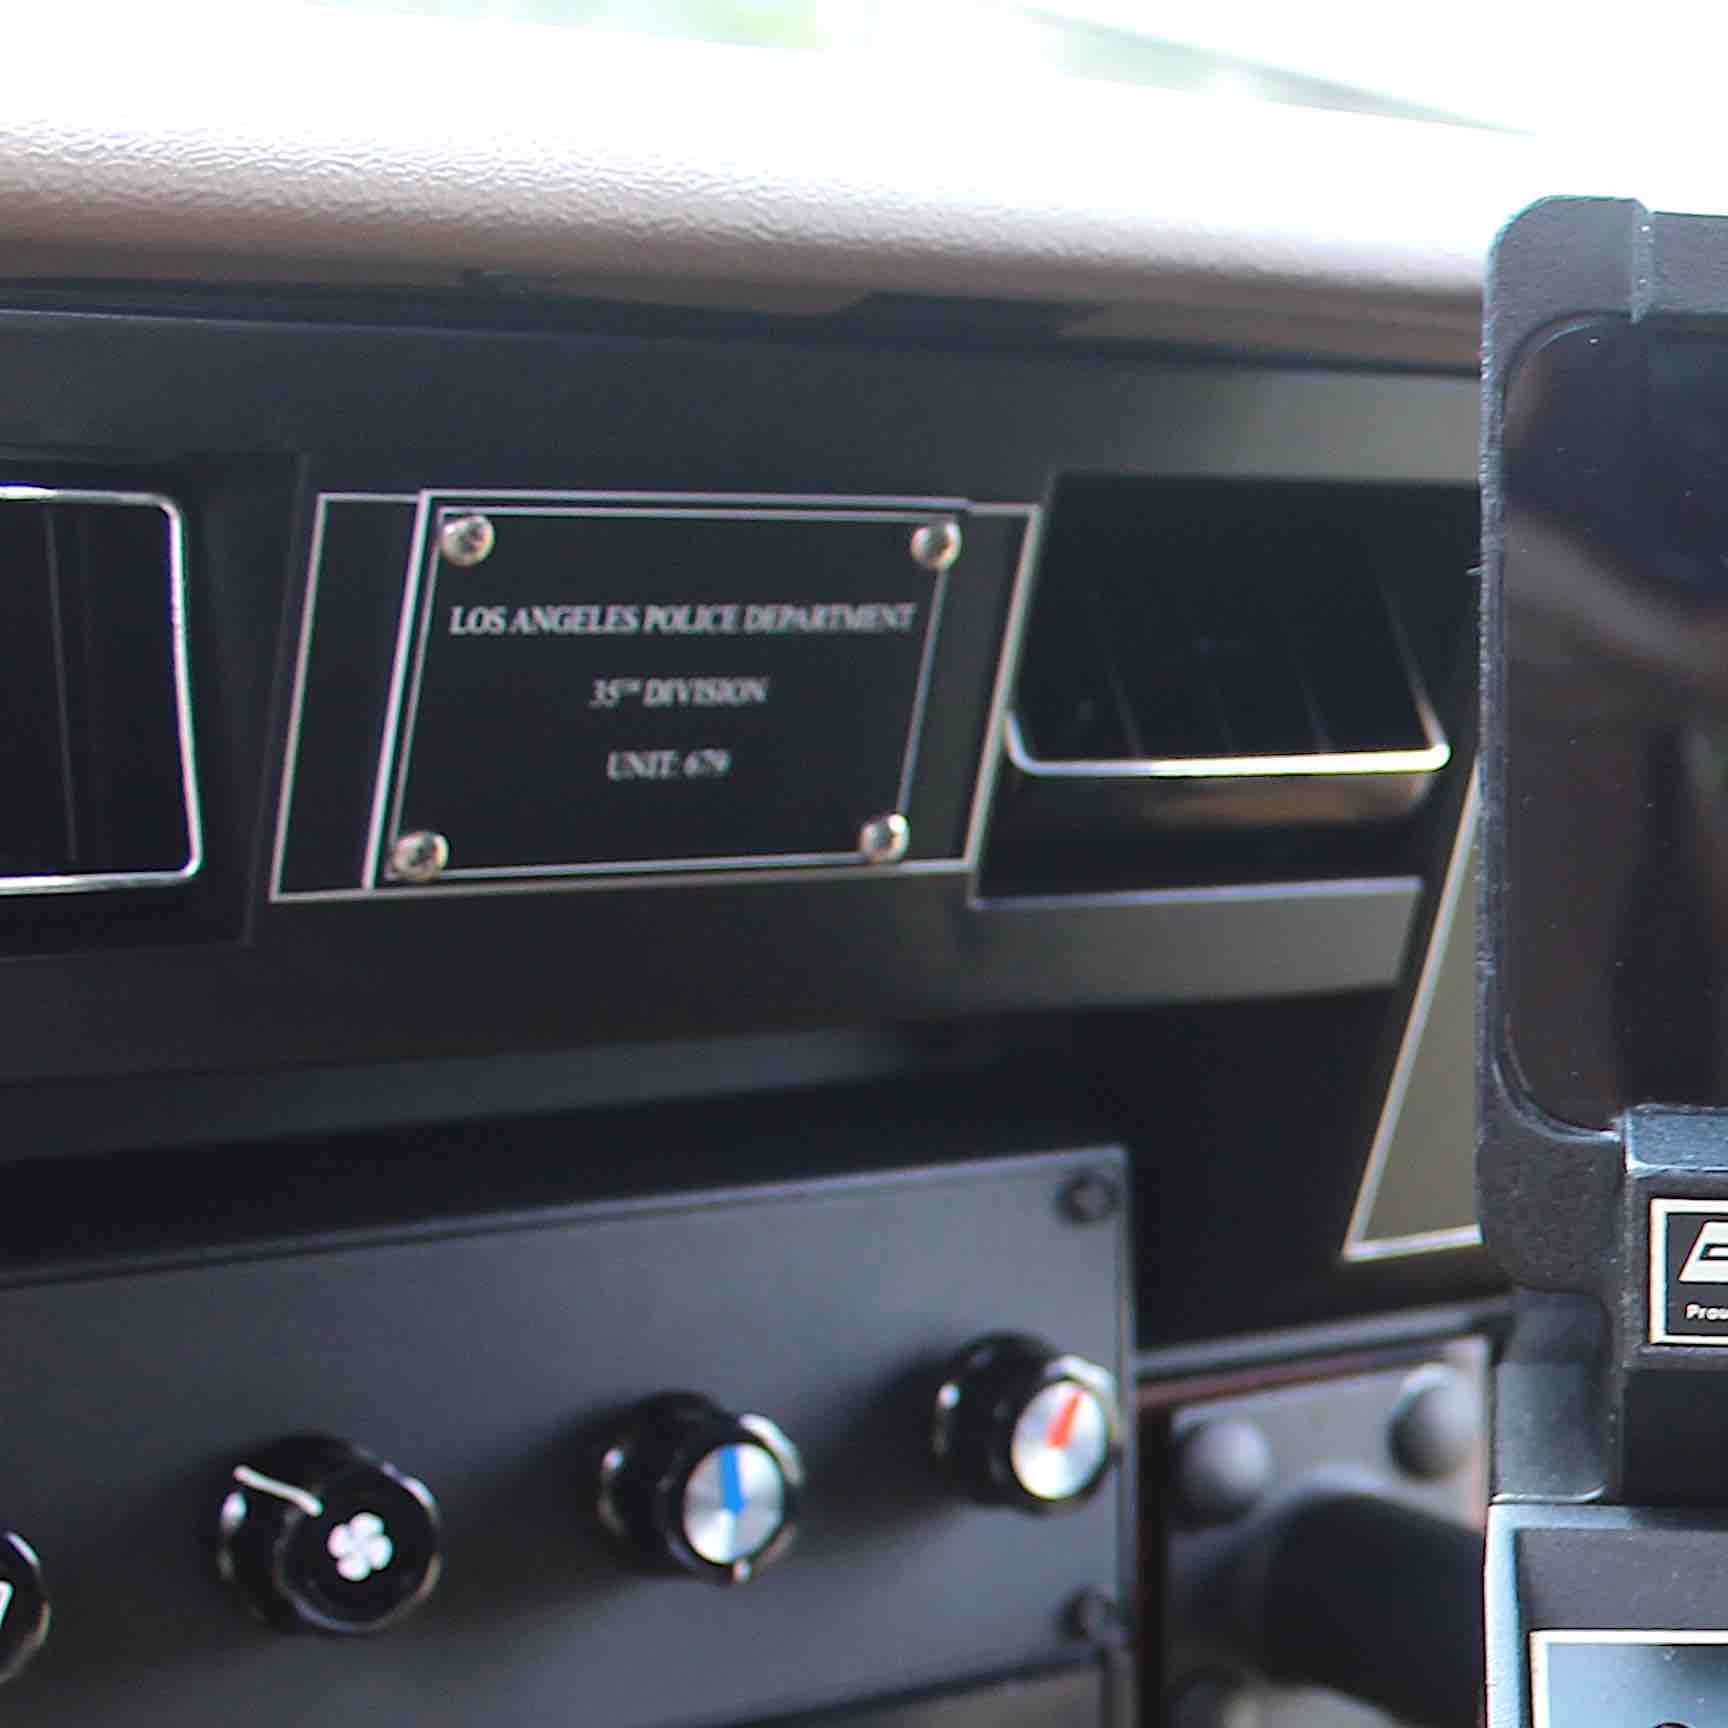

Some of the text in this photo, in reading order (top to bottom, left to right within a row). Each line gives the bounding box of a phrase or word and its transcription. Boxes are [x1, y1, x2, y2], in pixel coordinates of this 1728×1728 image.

[449, 602, 917, 635] LOS ANGELES POLICE DEPARTMENT
[643, 677, 769, 706] DIVISION
